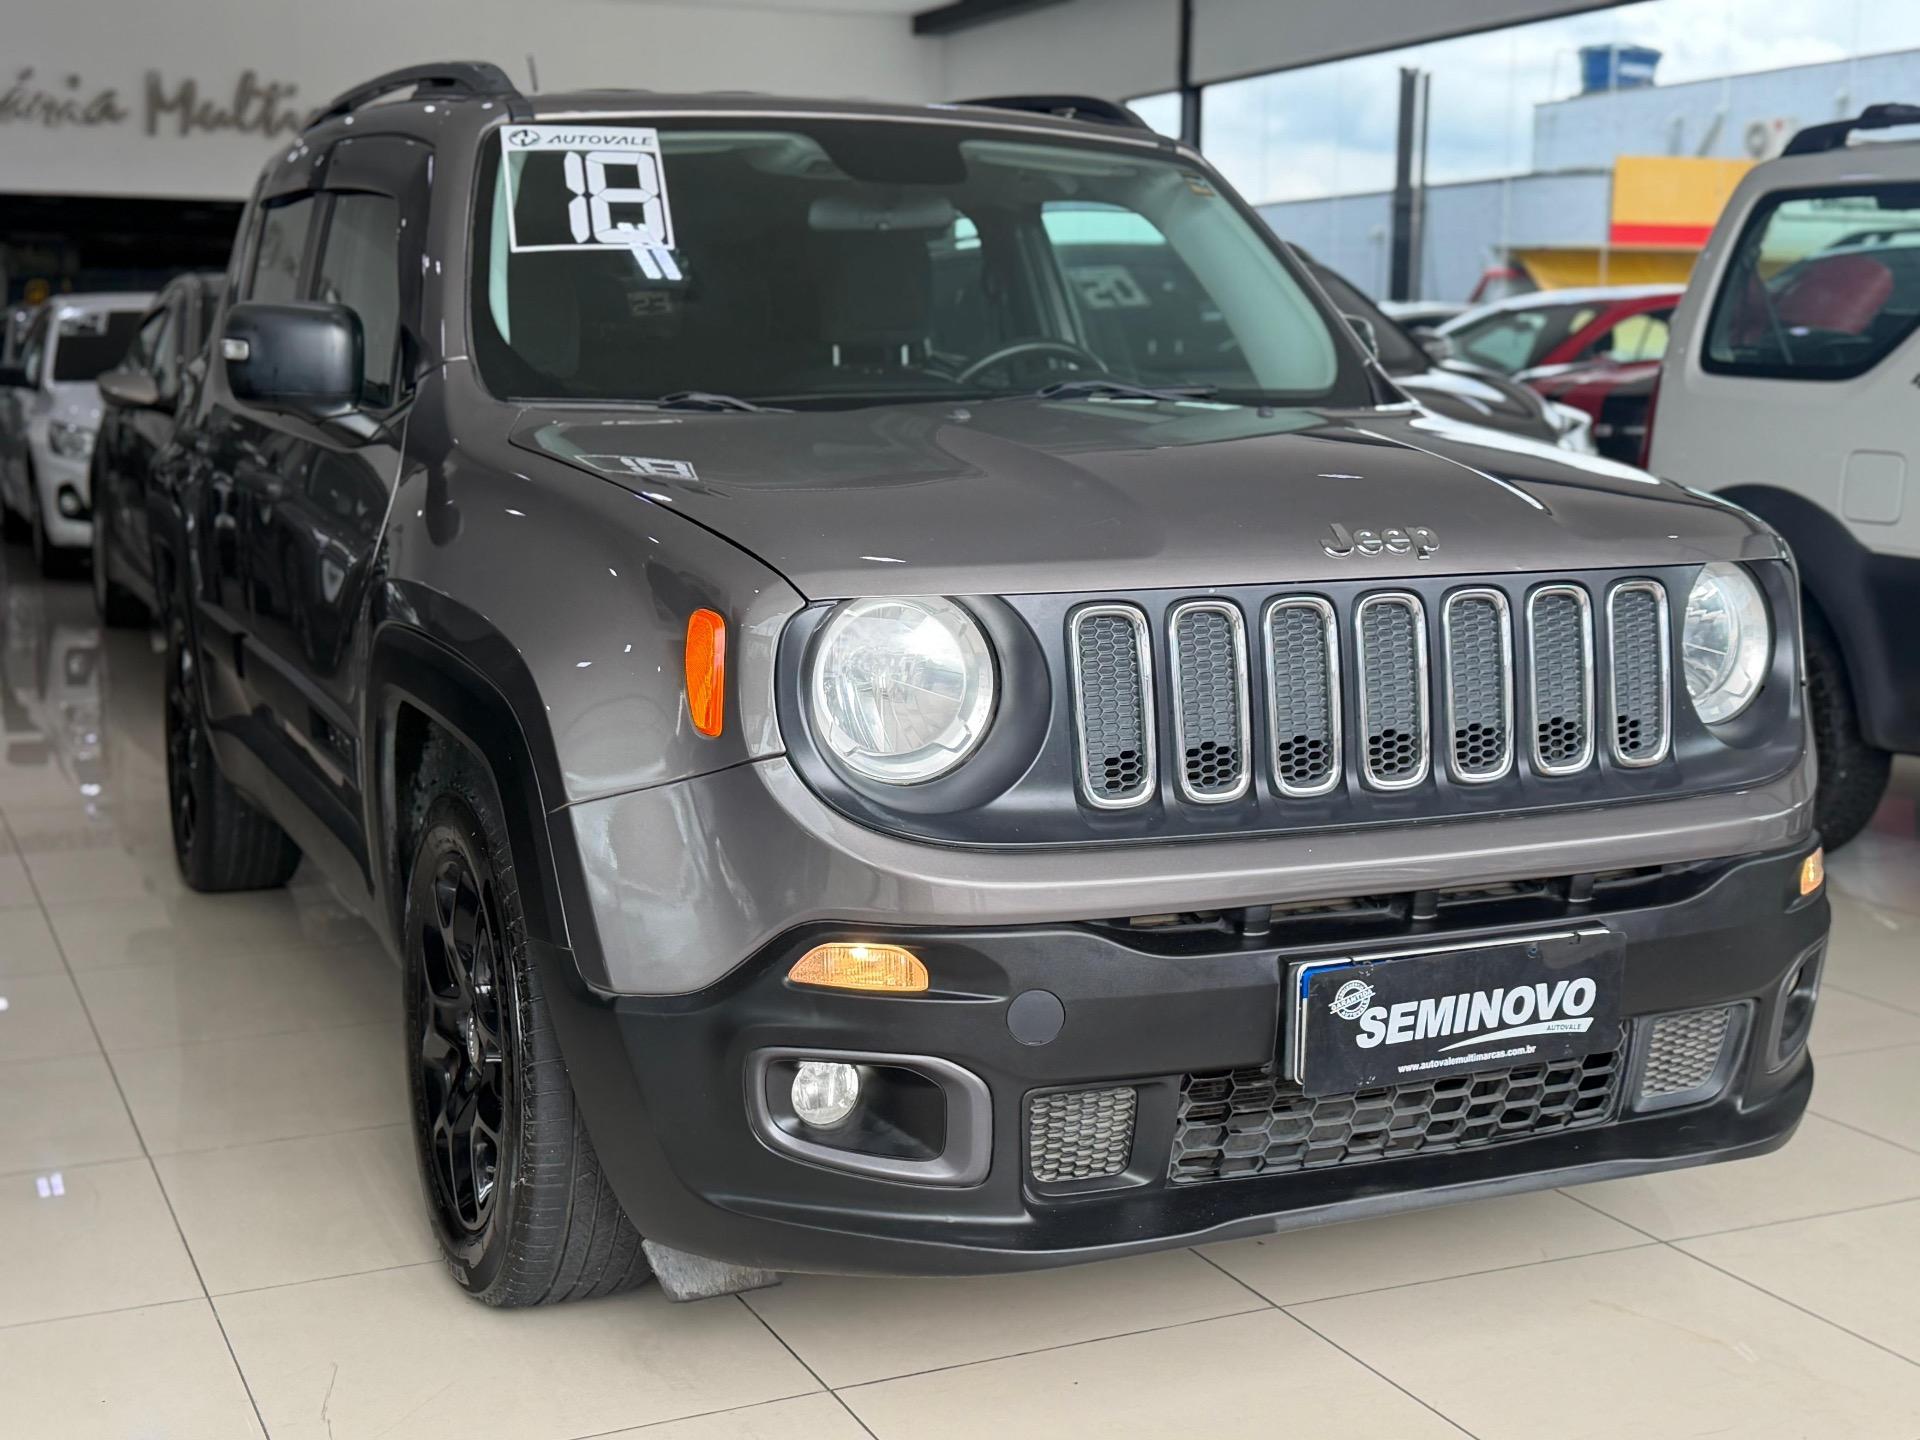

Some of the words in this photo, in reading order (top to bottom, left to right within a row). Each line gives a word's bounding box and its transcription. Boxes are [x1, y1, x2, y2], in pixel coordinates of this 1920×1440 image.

[144, 66, 322, 138] Multi
[547, 134, 654, 147] AUTOVALE
[563, 150, 667, 245] 18
[1319, 522, 1440, 561] Jeep
[1355, 977, 1597, 1049] SEMINOVO
[1546, 1023, 1582, 1031] AUTOVALE
[1397, 1044, 1537, 1073] www.autovalemultimarcas.com.br
